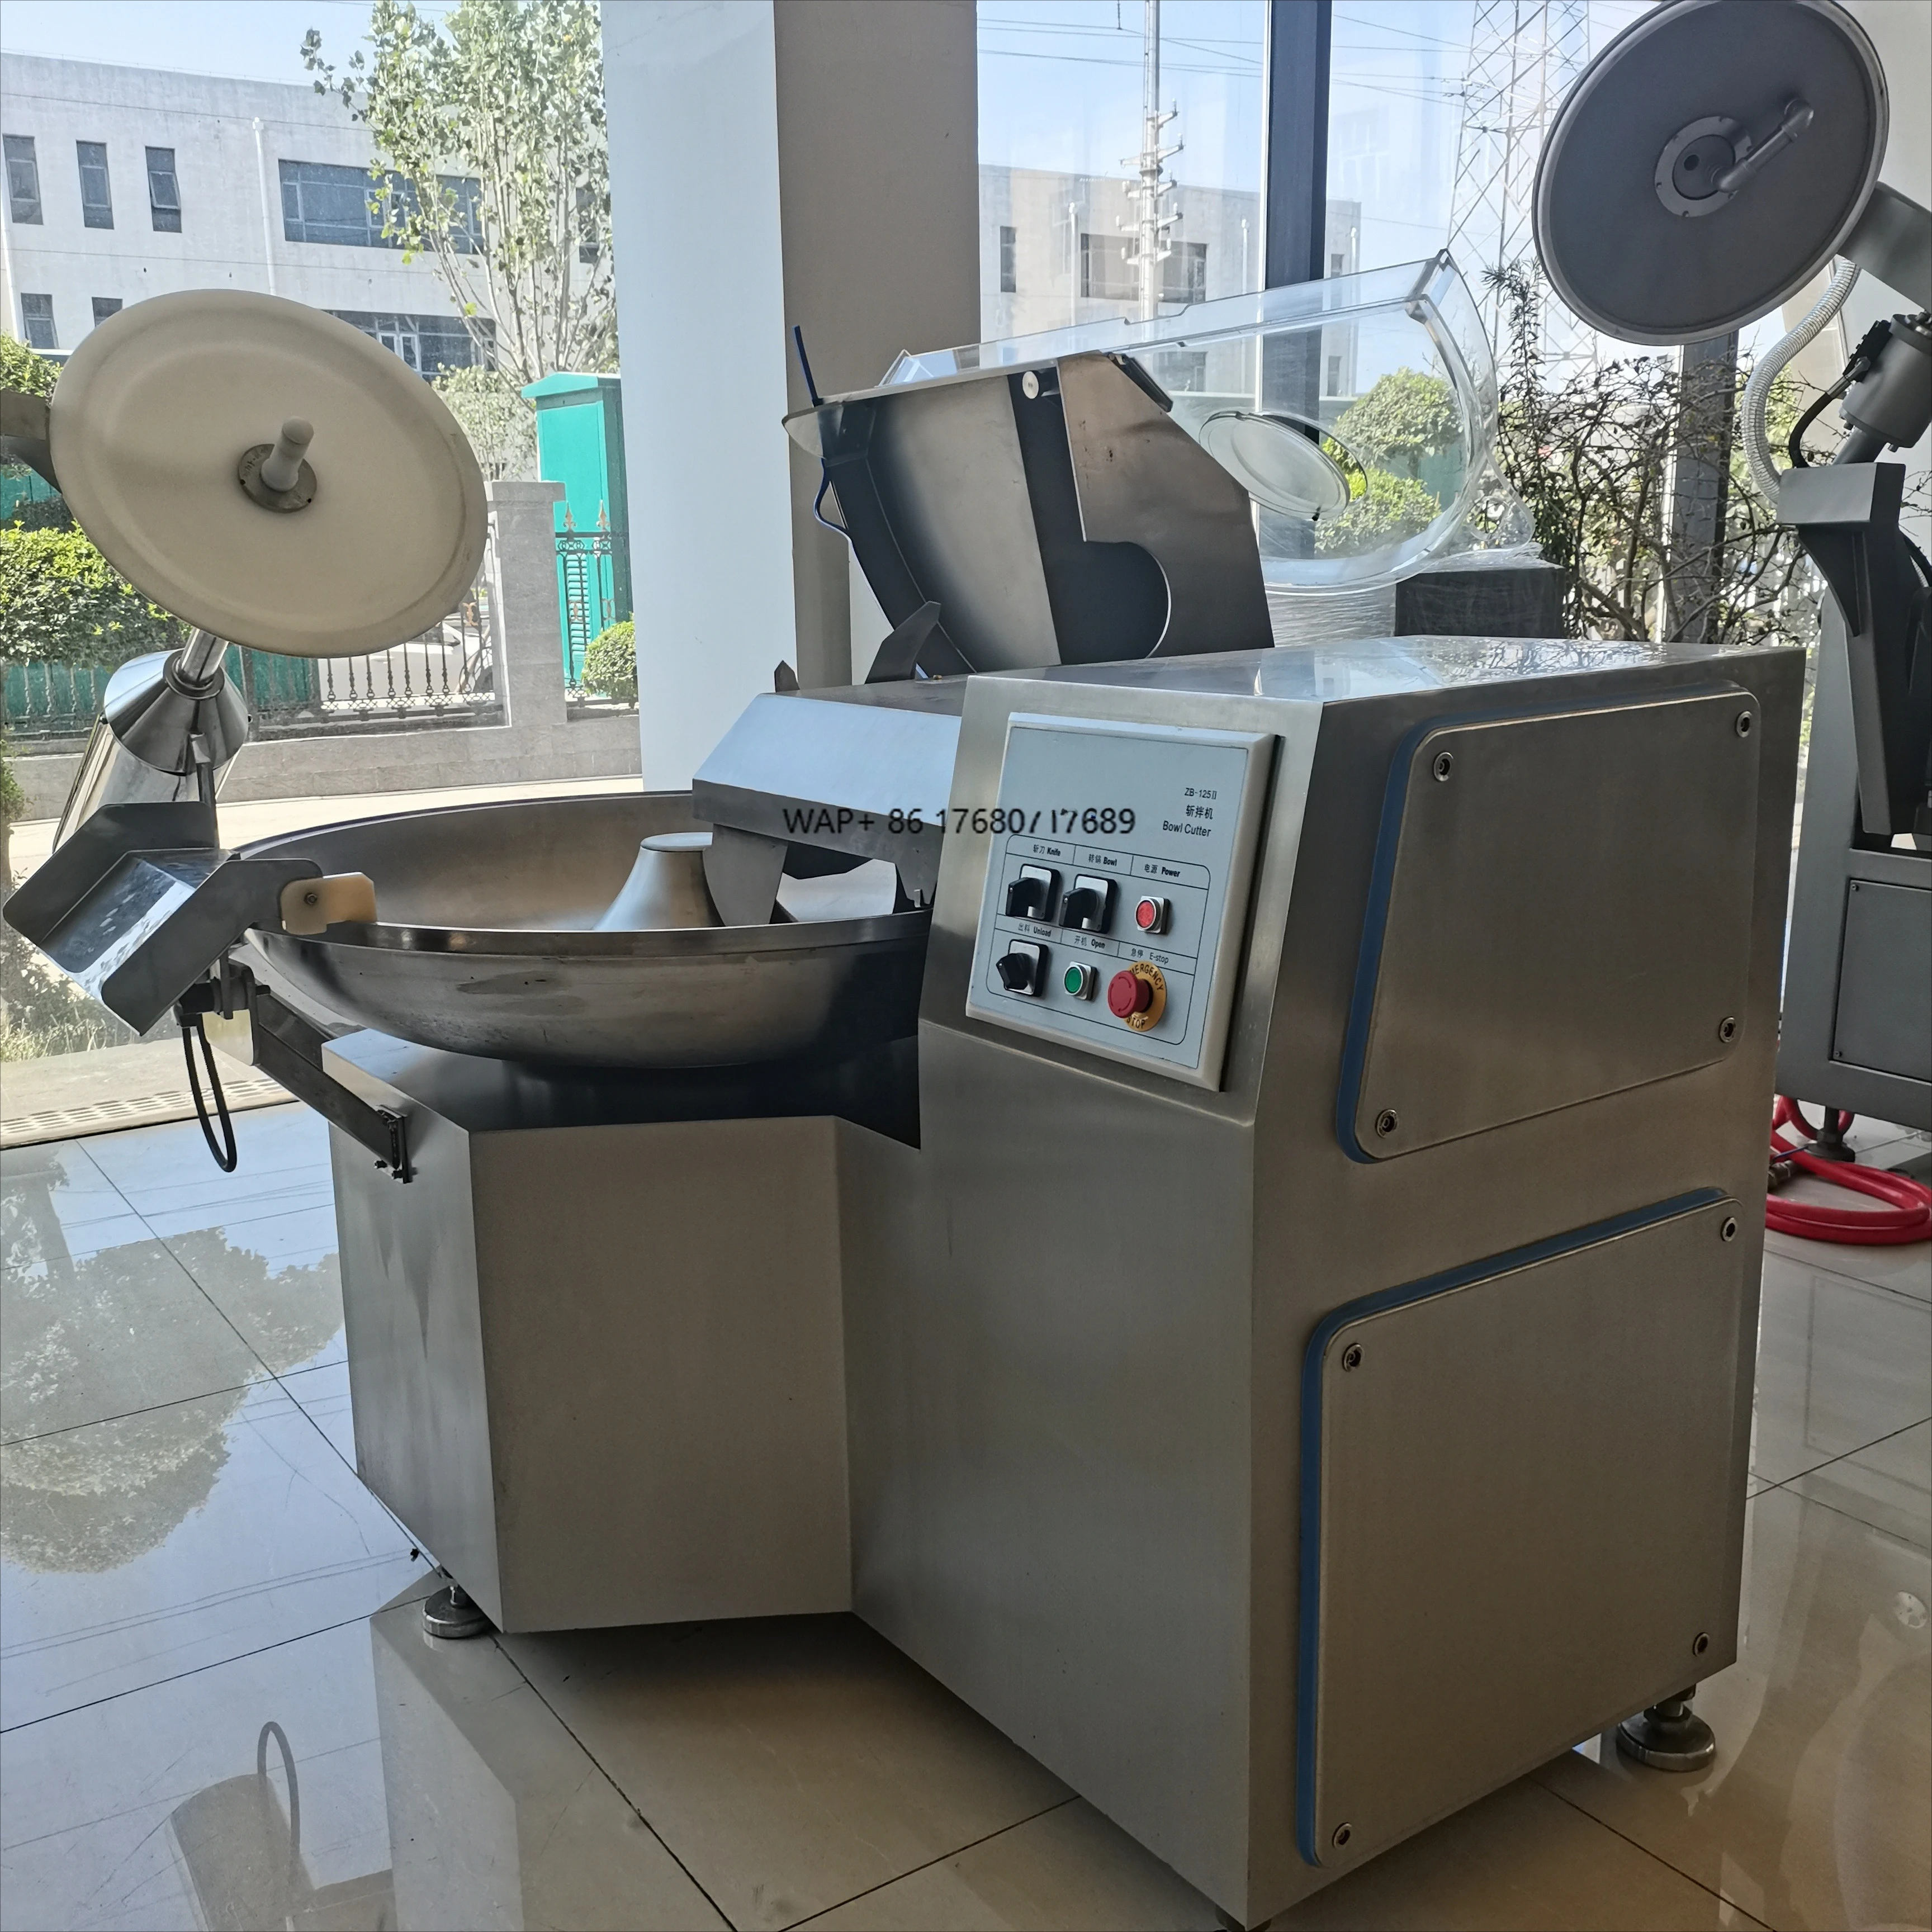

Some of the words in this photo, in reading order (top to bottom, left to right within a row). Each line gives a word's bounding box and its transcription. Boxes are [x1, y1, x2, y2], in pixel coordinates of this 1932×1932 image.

[1186, 804, 1213, 820] 斩拌机
[1163, 820, 1183, 833] Bowl
[1185, 823, 1211, 837] Cutter
[1047, 847, 1061, 856] Knife
[1103, 856, 1117, 866] Bowl
[1161, 866, 1180, 878] Power
[1033, 926, 1052, 937] Unload
[1091, 937, 1106, 949] Open
[1149, 952, 1169, 965] E-stop
[1126, 1015, 1146, 1029] STOP
